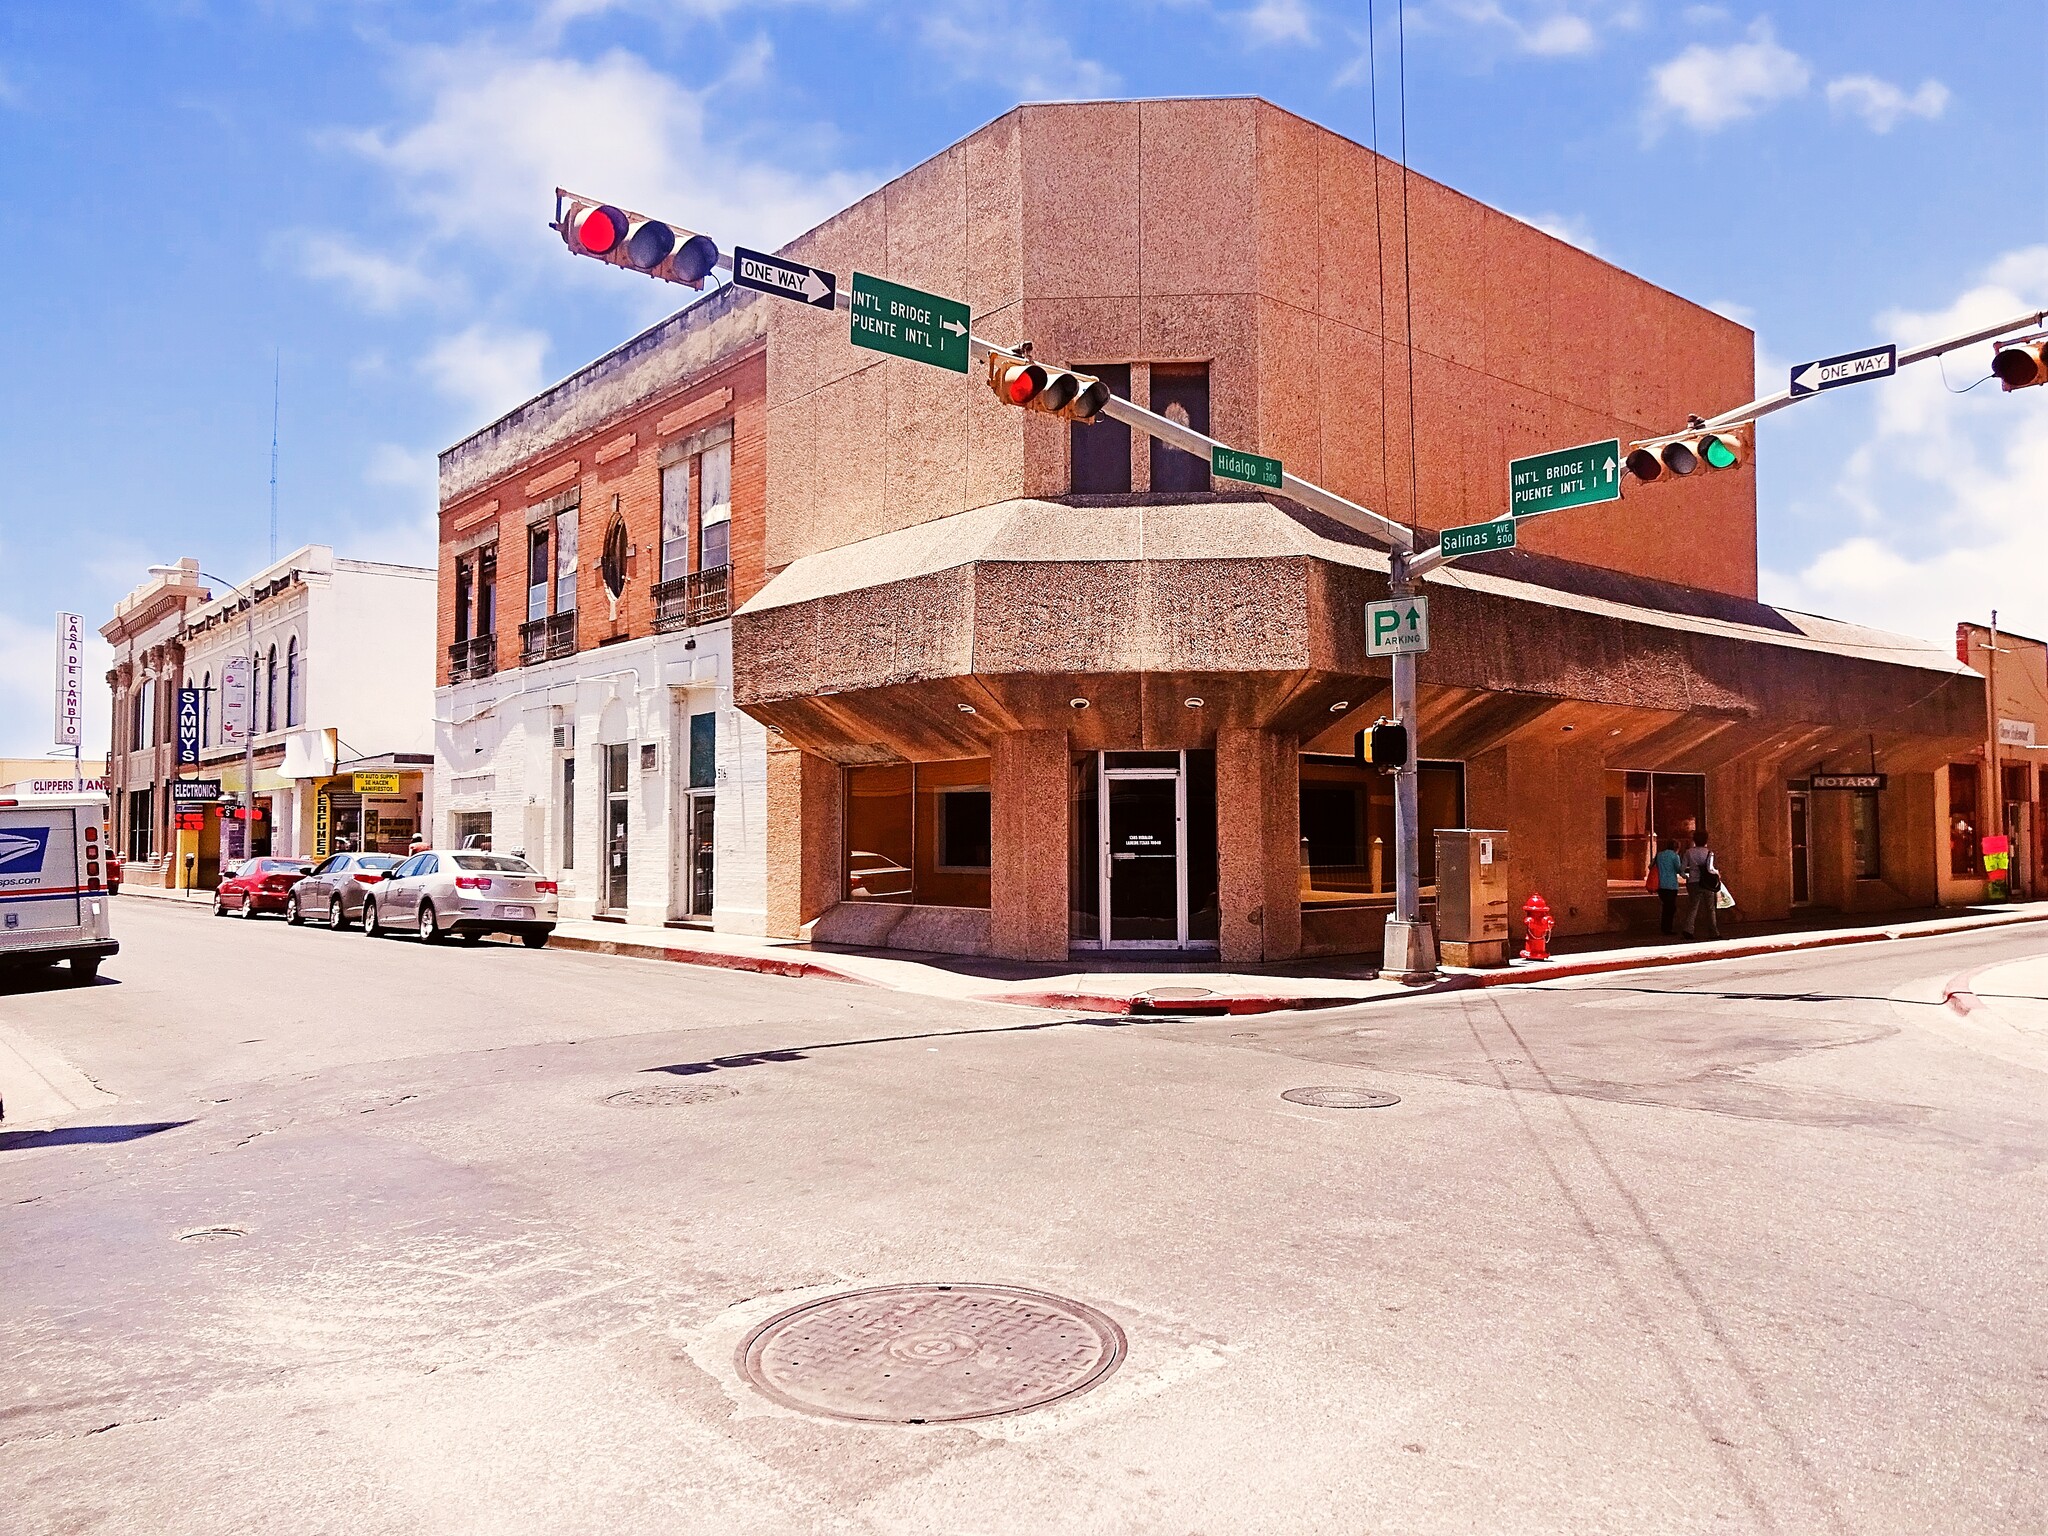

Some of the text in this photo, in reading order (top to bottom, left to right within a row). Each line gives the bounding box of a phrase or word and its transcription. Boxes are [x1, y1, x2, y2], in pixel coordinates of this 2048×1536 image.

[745, 261, 807, 291] ONE WAY
[853, 290, 881, 312] INT'L
[890, 301, 931, 325] BRIDGE
[852, 313, 897, 338] PUENTE
[905, 328, 932, 348] INT'L
[1821, 356, 1884, 380] ONE WAY
[1218, 454, 1272, 479] Hidalgo ST
[1263, 472, 1277, 483] 1300
[1515, 471, 1539, 486] INT'L
[1546, 461, 1583, 480] BRIDGE
[1516, 485, 1553, 503] PUENTE
[1560, 479, 1585, 494] INT'L
[1444, 523, 1509, 550] Salinas AVE
[1497, 533, 1512, 545] 500
[69, 616, 78, 651] CASA
[68, 655, 77, 674] DE
[181, 691, 197, 762] SAMMYS
[33, 780, 74, 791] CLIPPERS
[174, 784, 217, 798] ELECTRONICS
[1814, 776, 1878, 787] NOTARY
